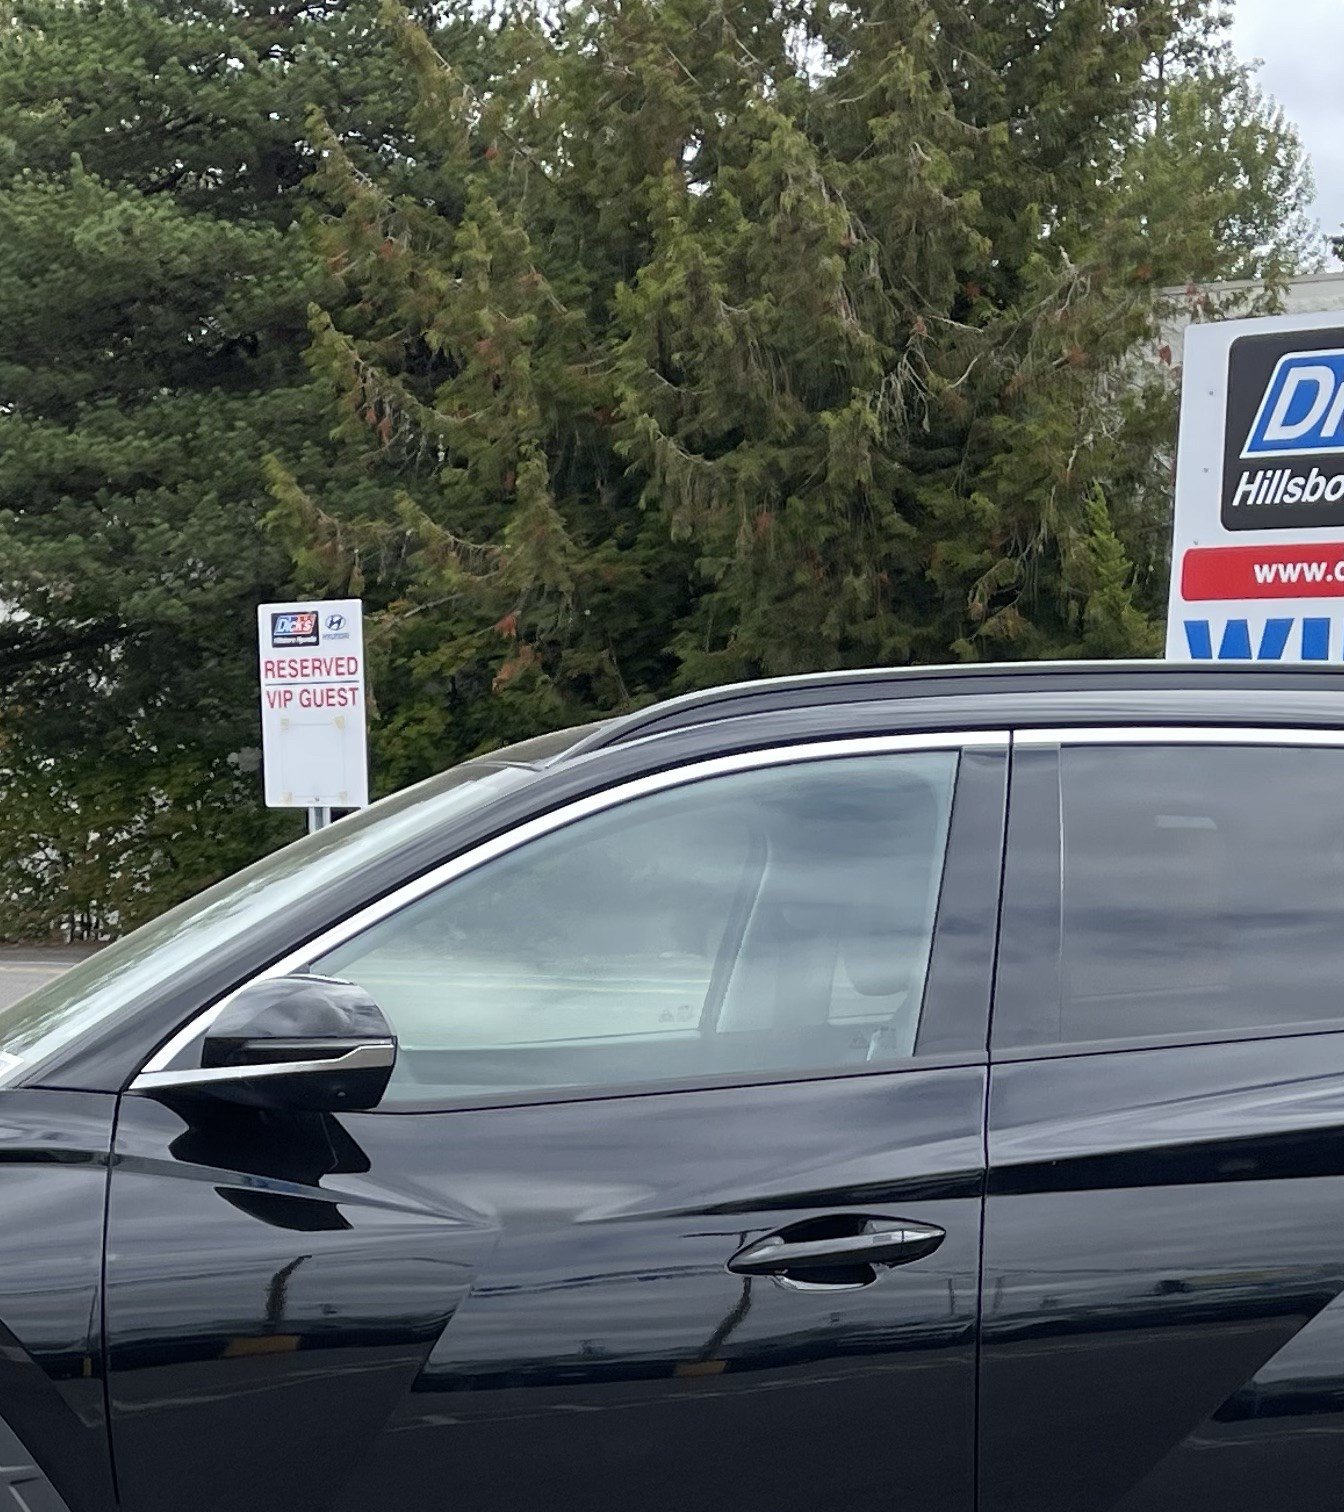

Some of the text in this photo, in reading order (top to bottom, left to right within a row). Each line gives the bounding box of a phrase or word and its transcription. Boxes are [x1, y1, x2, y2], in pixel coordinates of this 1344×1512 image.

[264, 656, 358, 678] RESERVED
[266, 687, 359, 709] VIP GUEST
